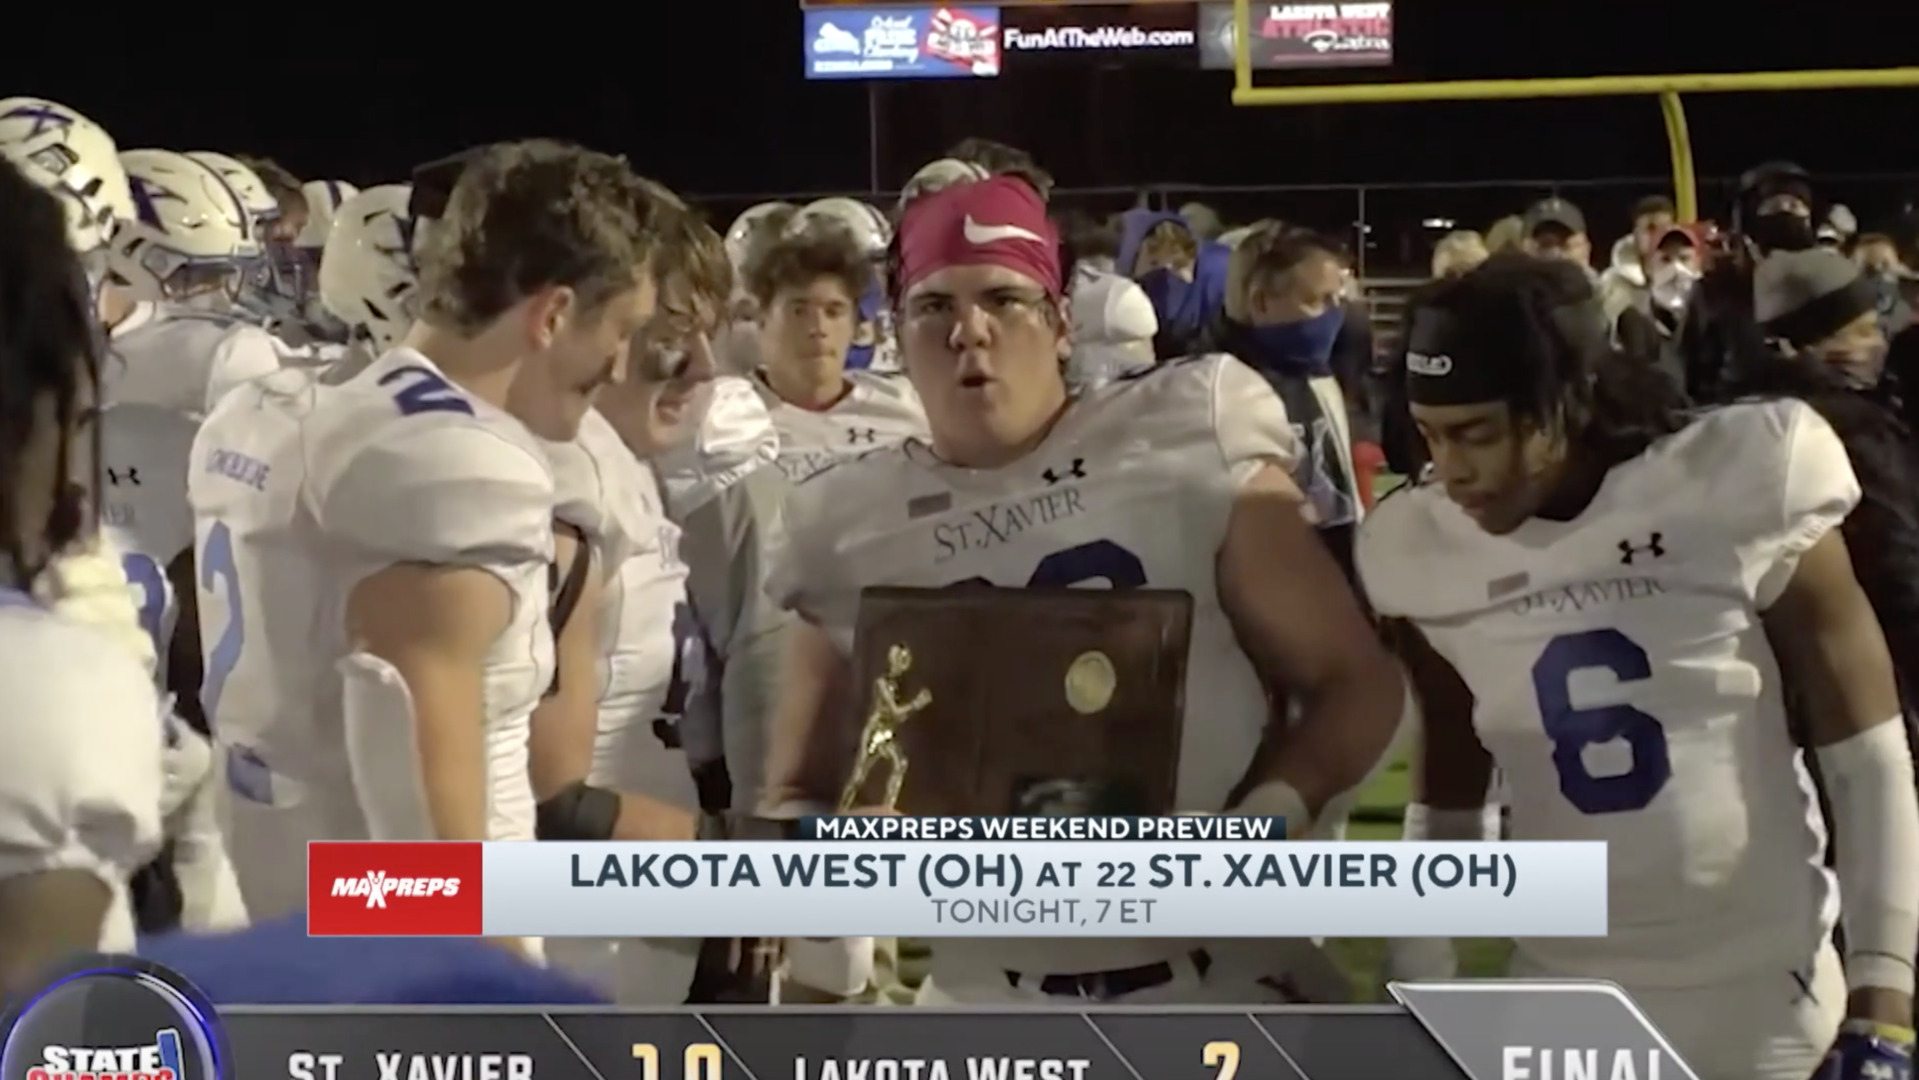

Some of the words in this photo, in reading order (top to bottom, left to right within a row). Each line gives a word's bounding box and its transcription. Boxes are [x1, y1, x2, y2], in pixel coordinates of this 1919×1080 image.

[1003, 27, 1195, 49] FunAtTheWeb.com
[378, 366, 475, 416] 2
[1532, 627, 1674, 815] 6
